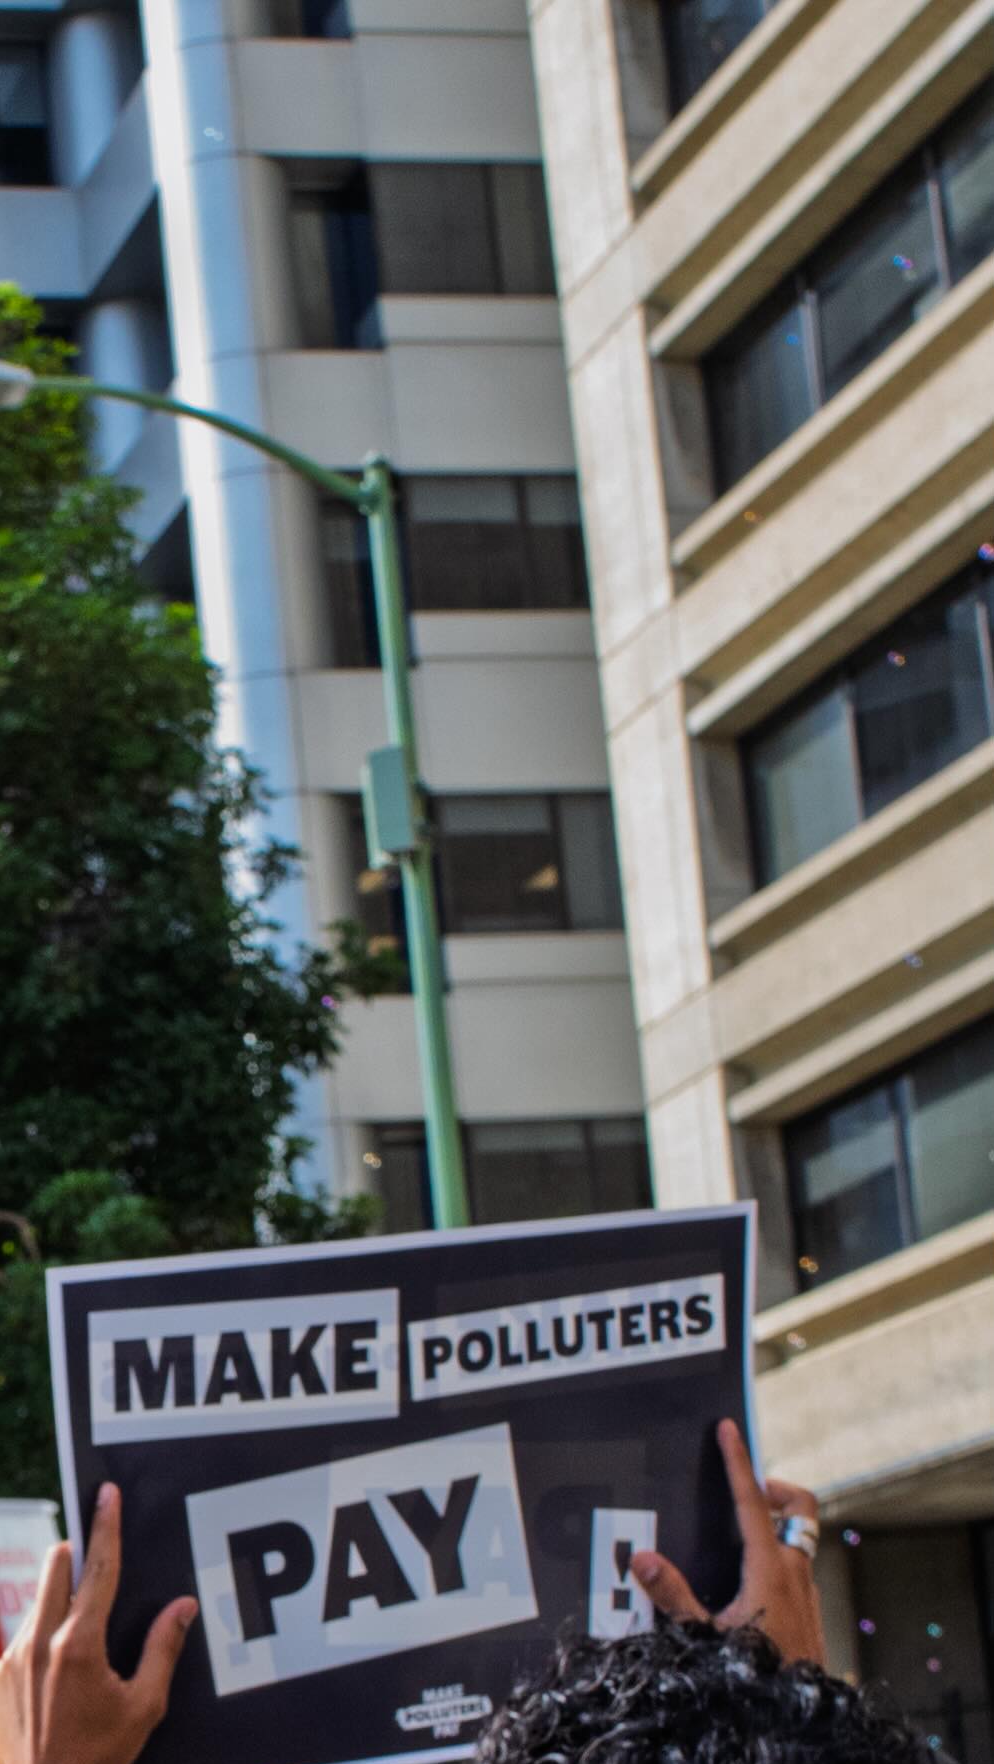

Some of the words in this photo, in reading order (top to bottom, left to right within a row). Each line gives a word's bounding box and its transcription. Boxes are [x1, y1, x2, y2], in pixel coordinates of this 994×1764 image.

[112, 1320, 378, 1413] MAKE
[421, 1294, 713, 1381] POLLUTERS
[225, 1475, 480, 1642] PAY
[611, 1540, 636, 1611] !
